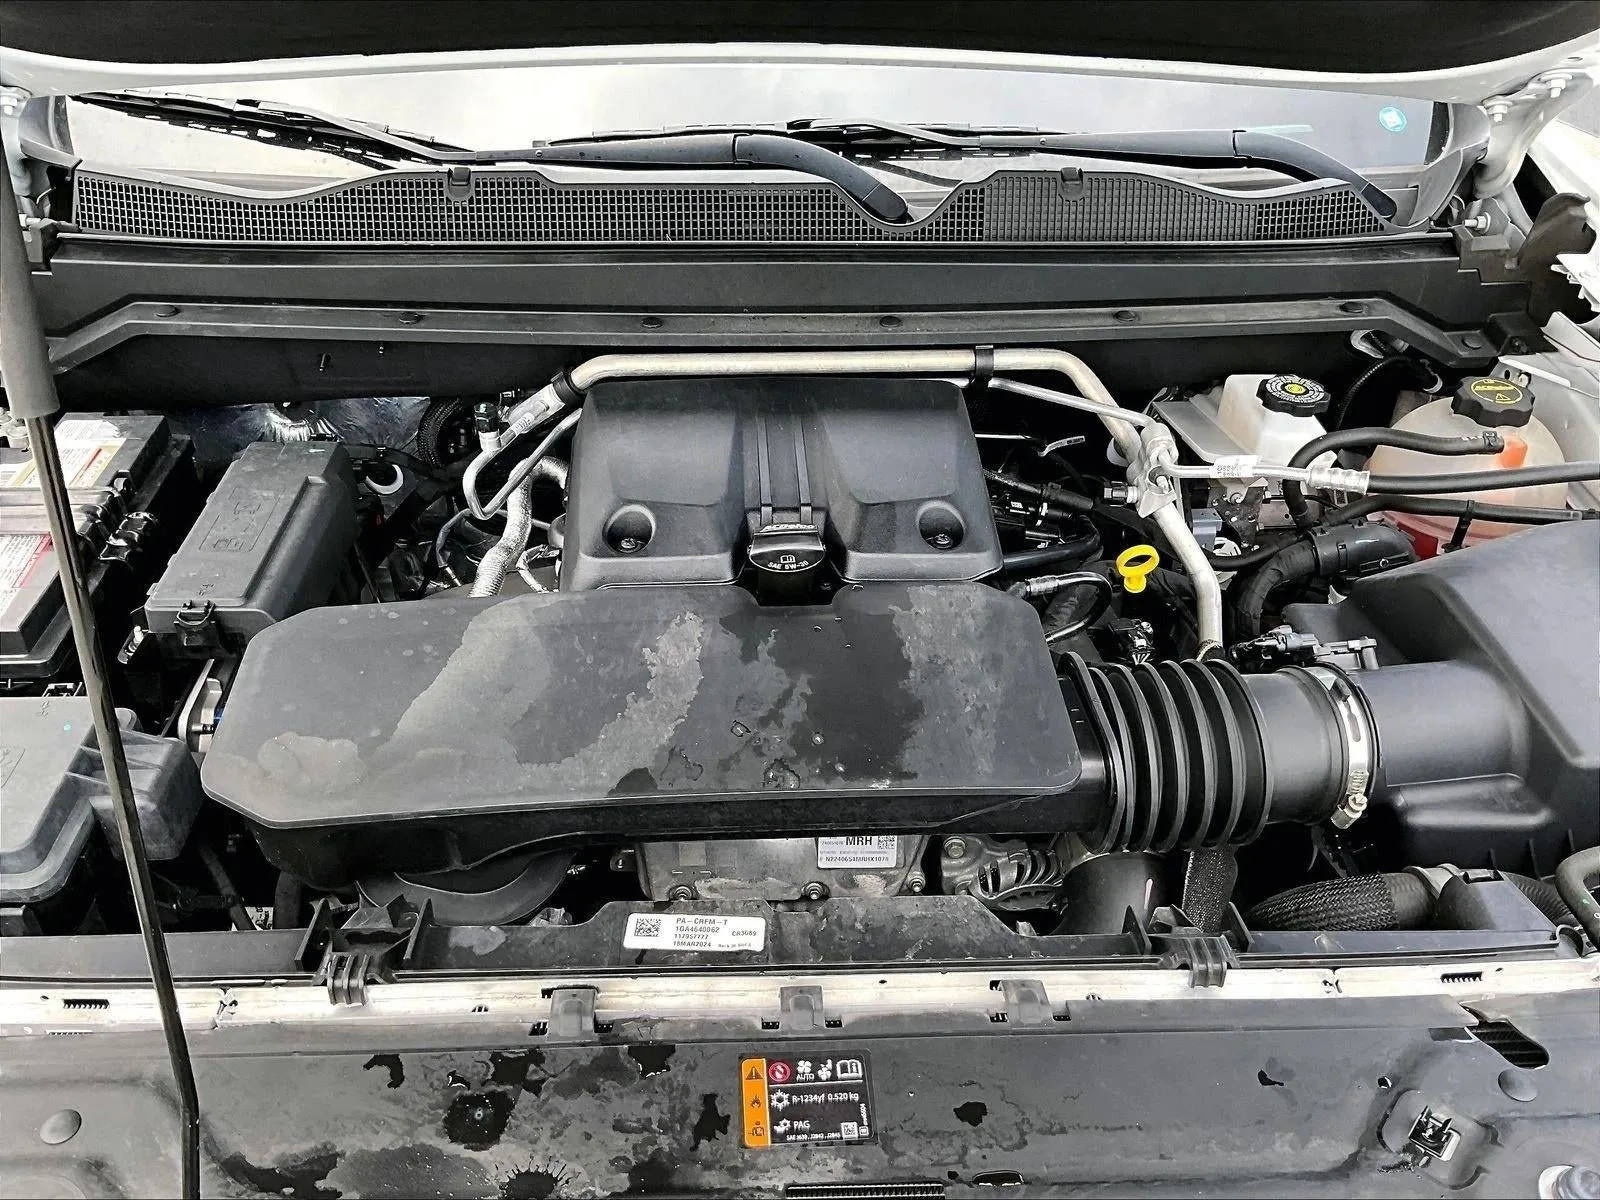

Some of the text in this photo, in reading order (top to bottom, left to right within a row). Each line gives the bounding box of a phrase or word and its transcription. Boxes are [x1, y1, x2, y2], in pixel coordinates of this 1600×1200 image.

[767, 561, 782, 570] SAE
[845, 836, 873, 846] MRH
[673, 940, 712, 948] 18MAR2024
[796, 1073, 815, 1081] AUTO
[792, 1092, 859, 1104] R-1234yf 0.520 kg
[793, 1120, 810, 1129] PAG
